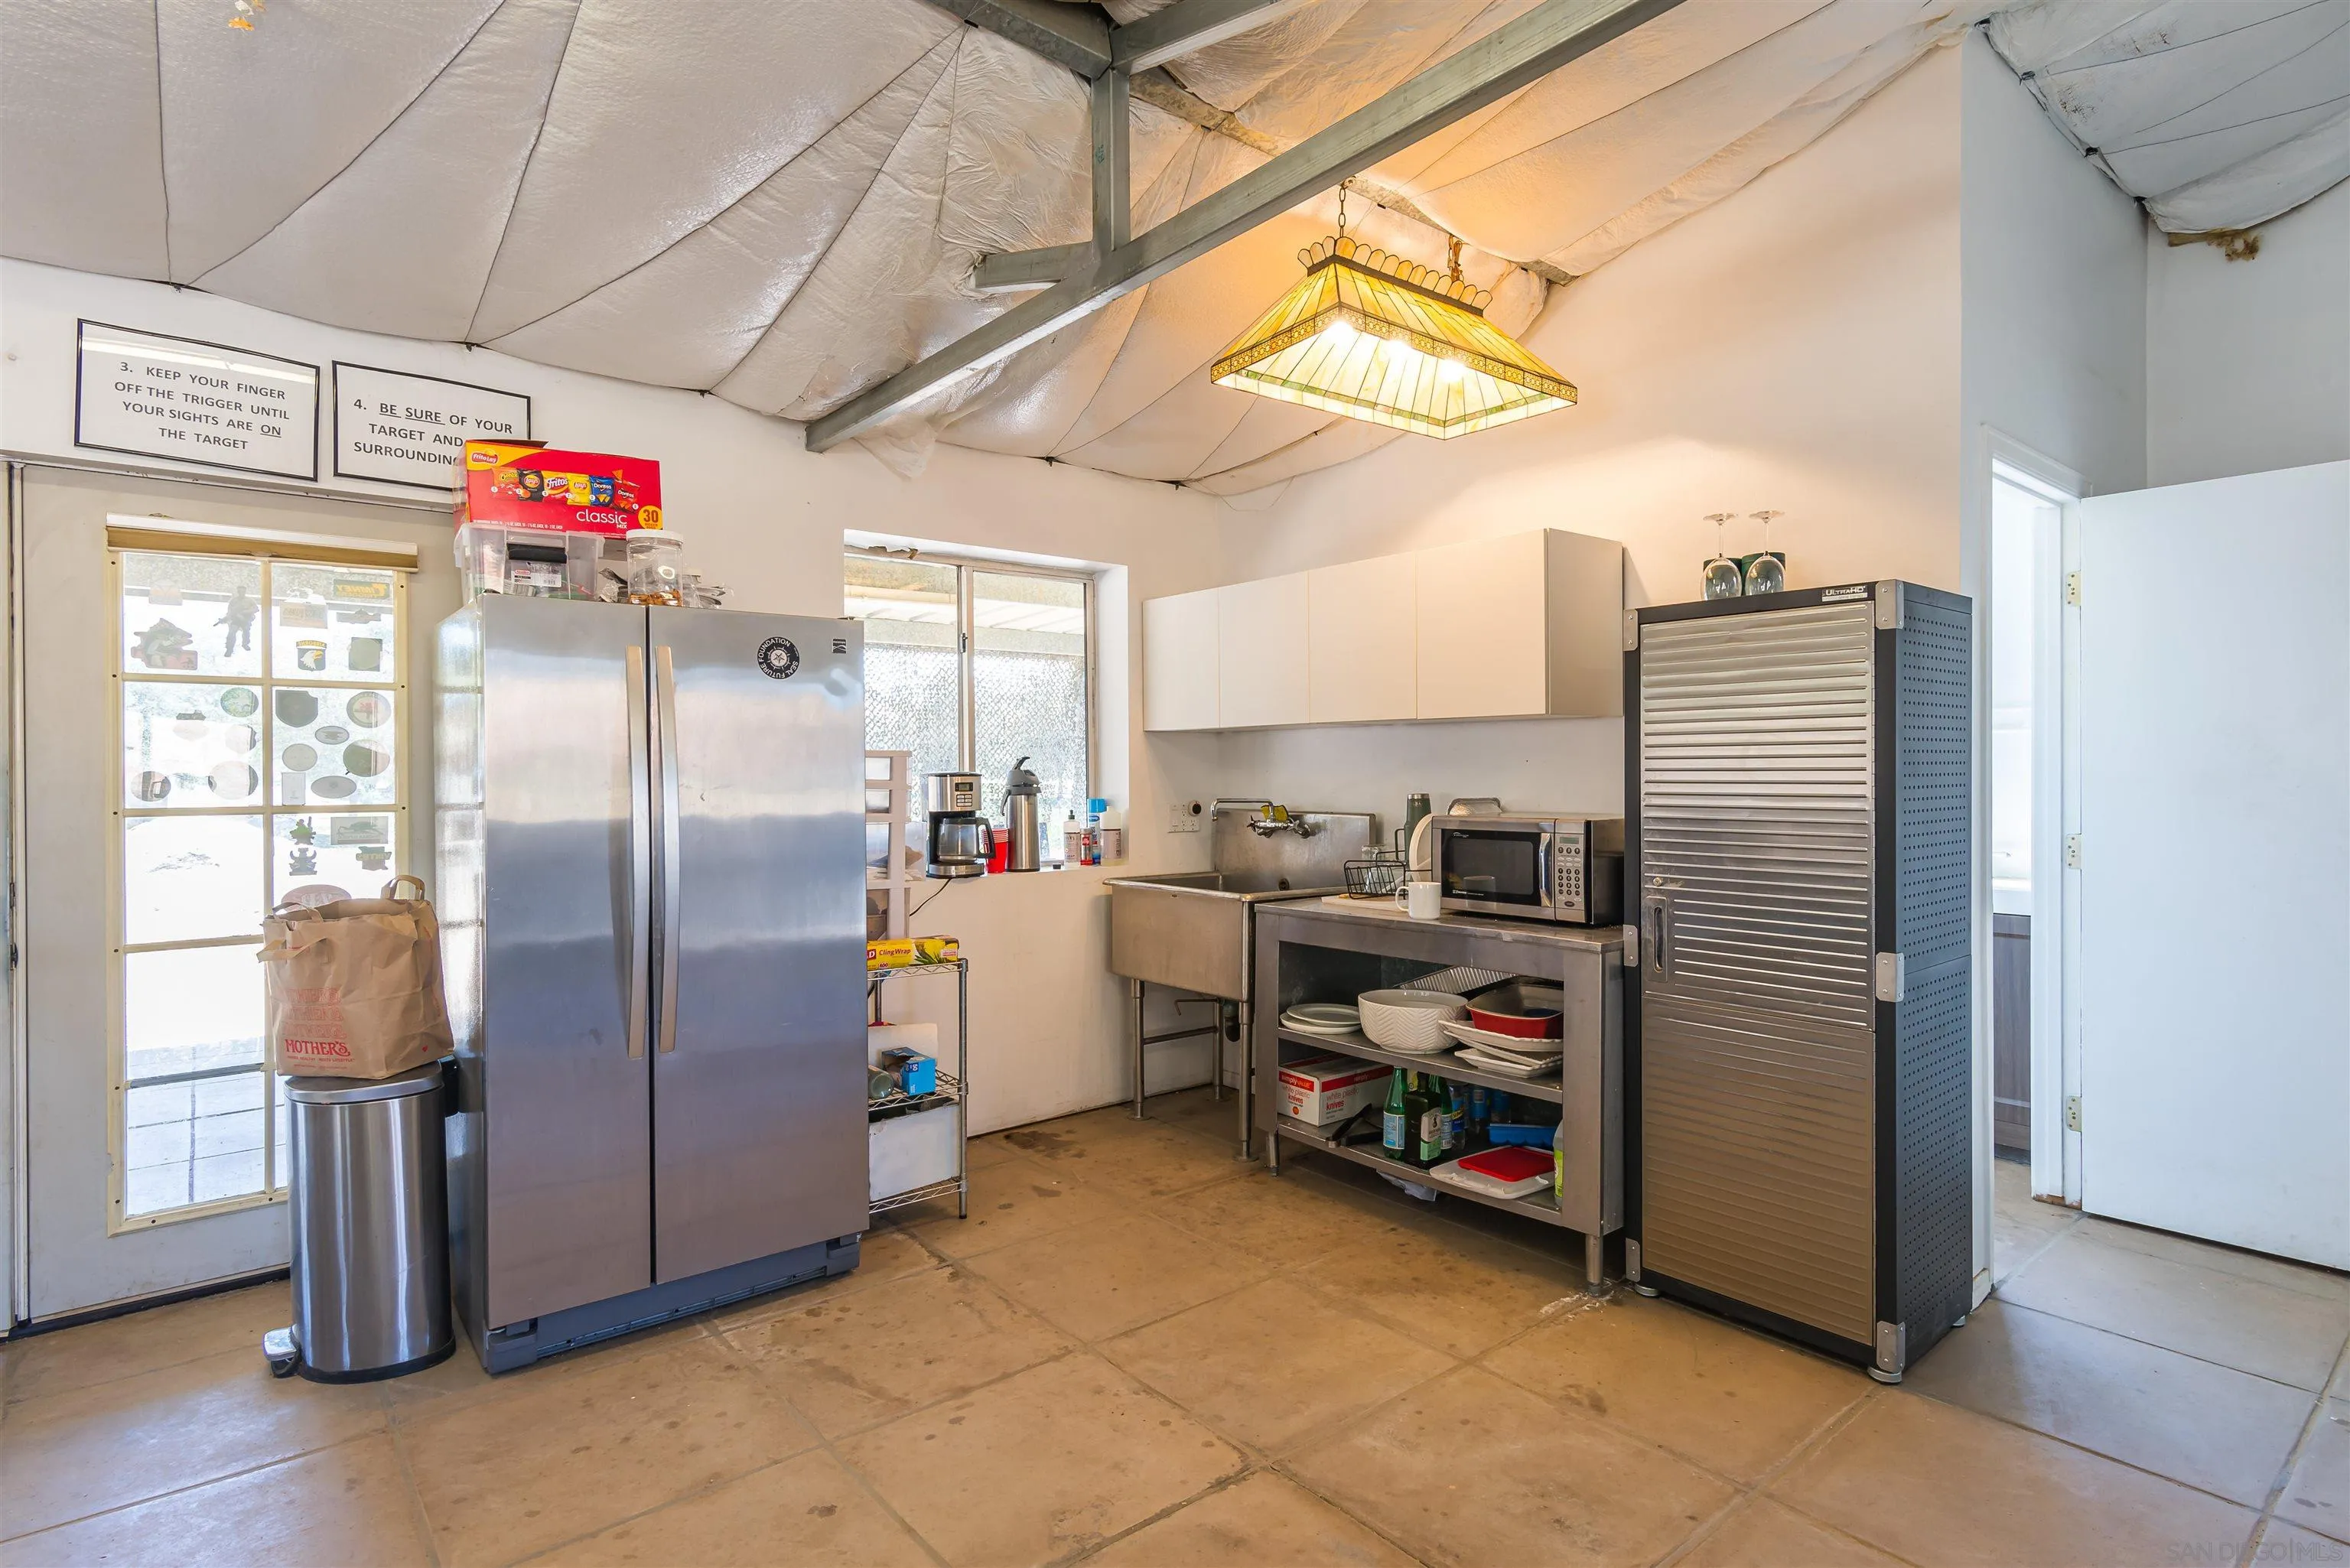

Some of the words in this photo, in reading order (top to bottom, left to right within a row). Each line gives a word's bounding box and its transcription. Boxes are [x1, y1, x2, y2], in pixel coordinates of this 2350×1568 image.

[120, 362, 133, 372] 3.
[146, 366, 181, 381] KEEP
[189, 374, 229, 390] YOUR
[237, 383, 285, 399] FINGER
[115, 382, 143, 394] OFF
[147, 386, 174, 400] THE
[182, 392, 242, 412] TRIGGER
[251, 405, 289, 420] UNTIL
[122, 402, 164, 417] YOUR
[169, 409, 219, 425] SIGHTS
[226, 419, 252, 431] ARE
[260, 425, 282, 437] ON
[353, 399, 367, 410] 4.
[379, 402, 397, 415] BE
[405, 407, 441, 422] SURE
[449, 415, 467, 426] OF
[475, 418, 513, 434] YOUR
[158, 428, 186, 441] THE
[194, 433, 249, 450] TARGET
[369, 423, 425, 441] TARGET
[432, 434, 464, 447] AND
[546, 477, 568, 490] Fritos
[617, 490, 634, 499] Doritos
[576, 509, 627, 525] classic
[643, 509, 659, 524] 30
[758, 637, 791, 662] FOUNDATION
[760, 662, 786, 678] FUTURE
[785, 661, 799, 675] SEAL
[285, 1039, 350, 1057] MOTHER'S
[1288, 1093, 1304, 1104] knives
[1326, 1101, 1344, 1111] knives
